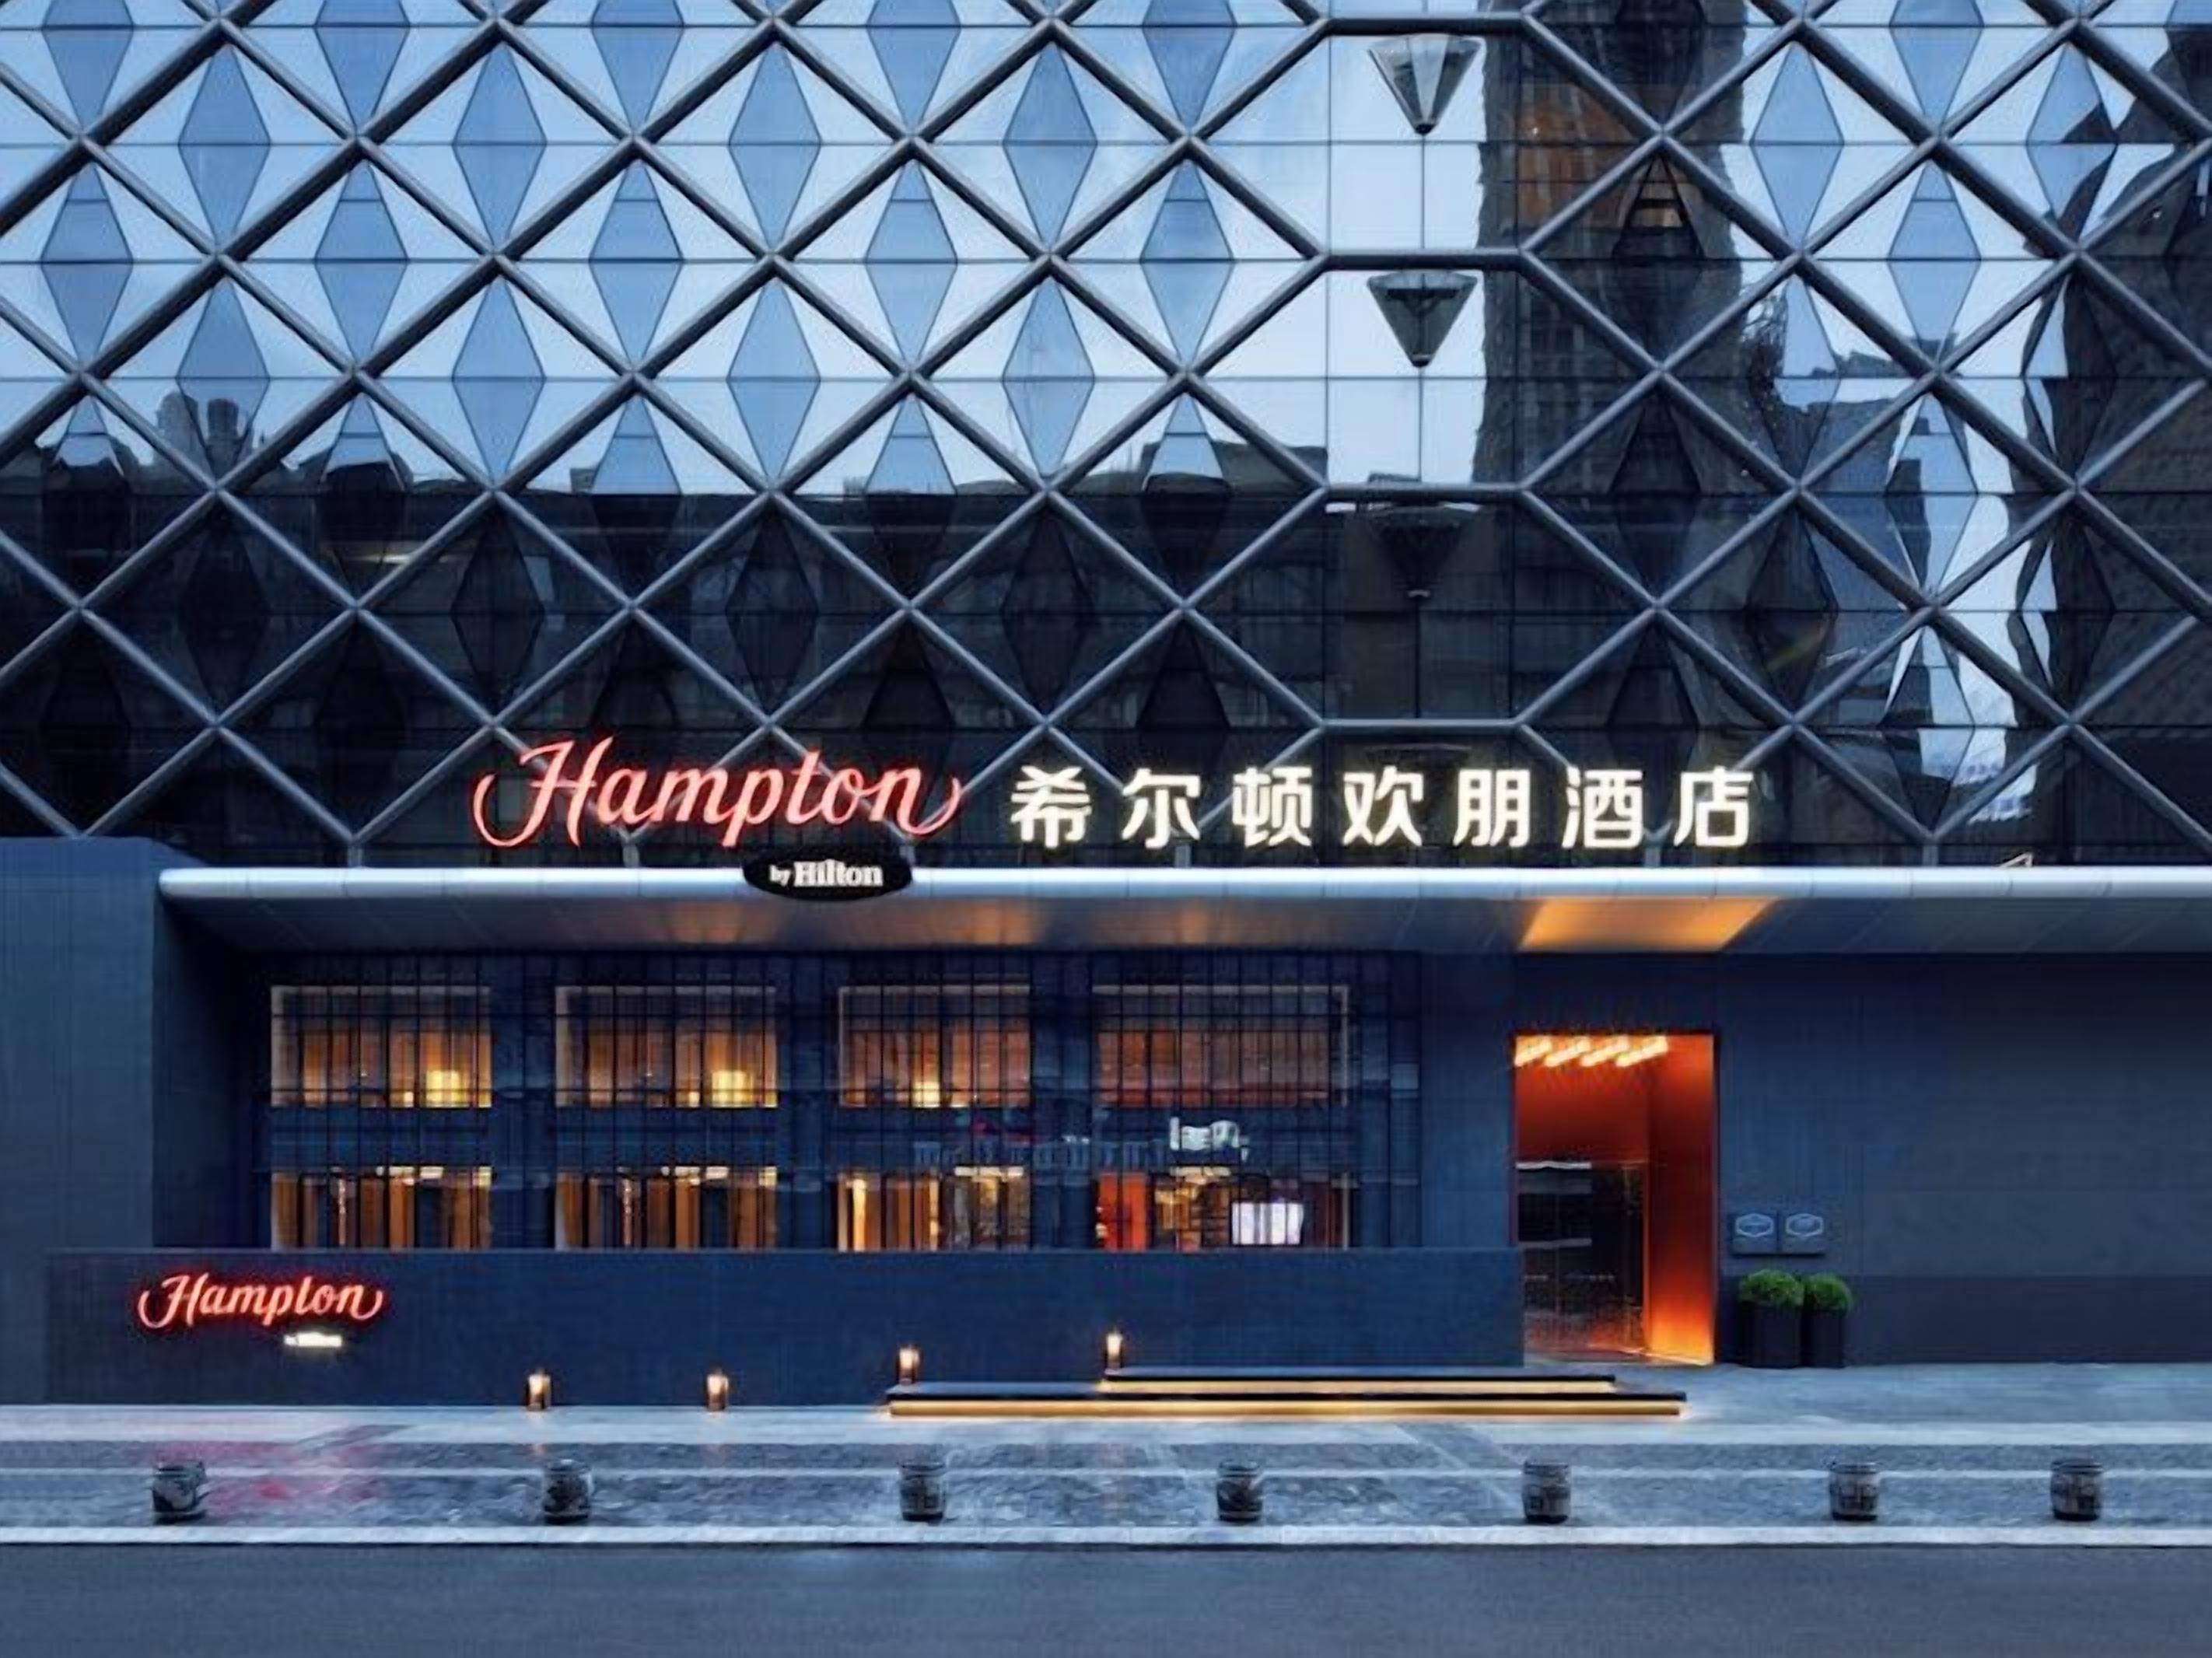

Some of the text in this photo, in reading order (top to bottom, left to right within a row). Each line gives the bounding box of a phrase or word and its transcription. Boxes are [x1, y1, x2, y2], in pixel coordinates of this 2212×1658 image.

[472, 736, 962, 848] Hampton
[1010, 764, 1755, 850] 希尔顿欢朋酒店
[769, 859, 884, 887] by Hilton
[137, 1271, 384, 1329] Hampton
